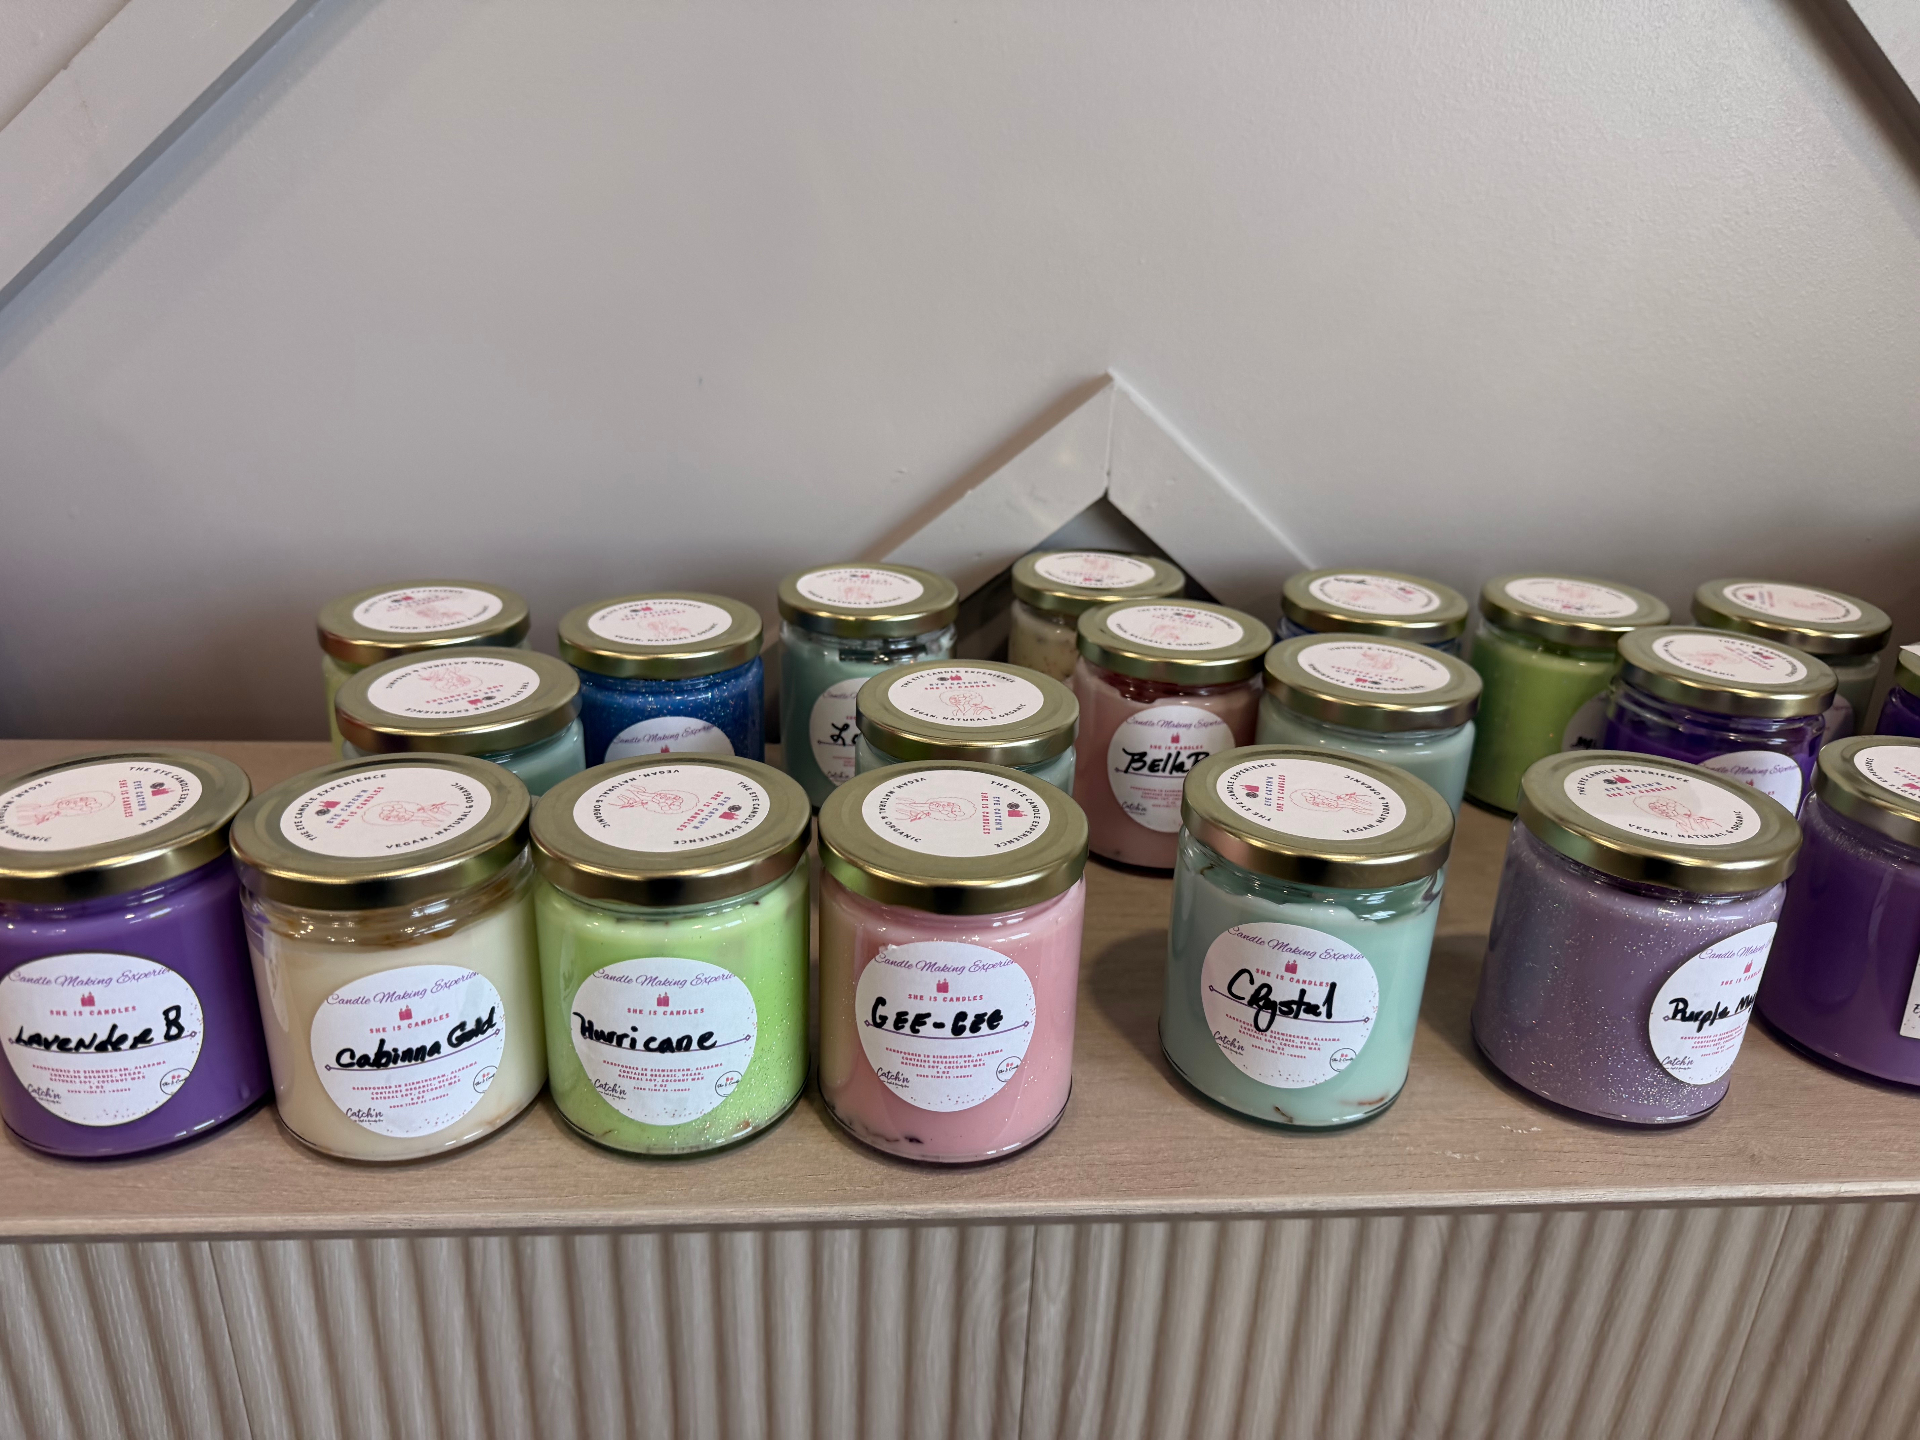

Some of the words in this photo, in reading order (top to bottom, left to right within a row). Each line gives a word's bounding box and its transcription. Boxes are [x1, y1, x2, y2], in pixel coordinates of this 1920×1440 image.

[964, 670, 1016, 683] EXPERIENCE
[639, 769, 679, 778] VEGAN,
[1232, 763, 1276, 780] EXPERIENCE
[172, 773, 189, 794] CANDLE
[318, 774, 386, 796] EXPERIENCE
[451, 783, 474, 803] ORGANIC
[599, 777, 637, 798] NATURAL
[738, 782, 752, 791] THE
[893, 777, 926, 790] VEGAN,
[1227, 781, 1239, 800] CANDLE
[1344, 775, 1381, 796] ORGANIC
[139, 793, 188, 827] EXPERIENCE
[298, 796, 317, 820] CANDLE
[879, 789, 896, 815] NATURAL
[1026, 798, 1041, 821] CANDLE
[435, 810, 471, 835] NATURAL
[593, 804, 610, 828] ORGANIC
[741, 803, 760, 825] CANDLE
[1376, 802, 1390, 824] NATURAL
[301, 830, 317, 840] THE
[673, 826, 742, 845] EXPERIENCE
[885, 821, 921, 842] ORGANIC
[994, 820, 1041, 848] EXPERIENCE
[386, 836, 433, 849] VEGAN,
[1227, 927, 1265, 945] Candle
[1268, 938, 1317, 959] Making
[874, 951, 913, 970] Candle
[915, 960, 965, 975] Making
[1699, 949, 1735, 959] Candle
[8, 970, 52, 986] Candle
[53, 974, 113, 987] Making
[592, 968, 633, 984] Candle
[636, 974, 687, 988] Making
[1255, 968, 1271, 977] SHE
[1289, 977, 1330, 987] CANDLES
[326, 993, 371, 1005] Candle
[373, 988, 427, 1004] Making
[89, 1006, 137, 1016] CANDLES
[408, 1013, 450, 1029] CANDLES
[663, 1008, 705, 1016] CANDLES
[1669, 997, 1730, 1033] Purple
[163, 1005, 184, 1041] B
[573, 1012, 717, 1054] Hurricane
